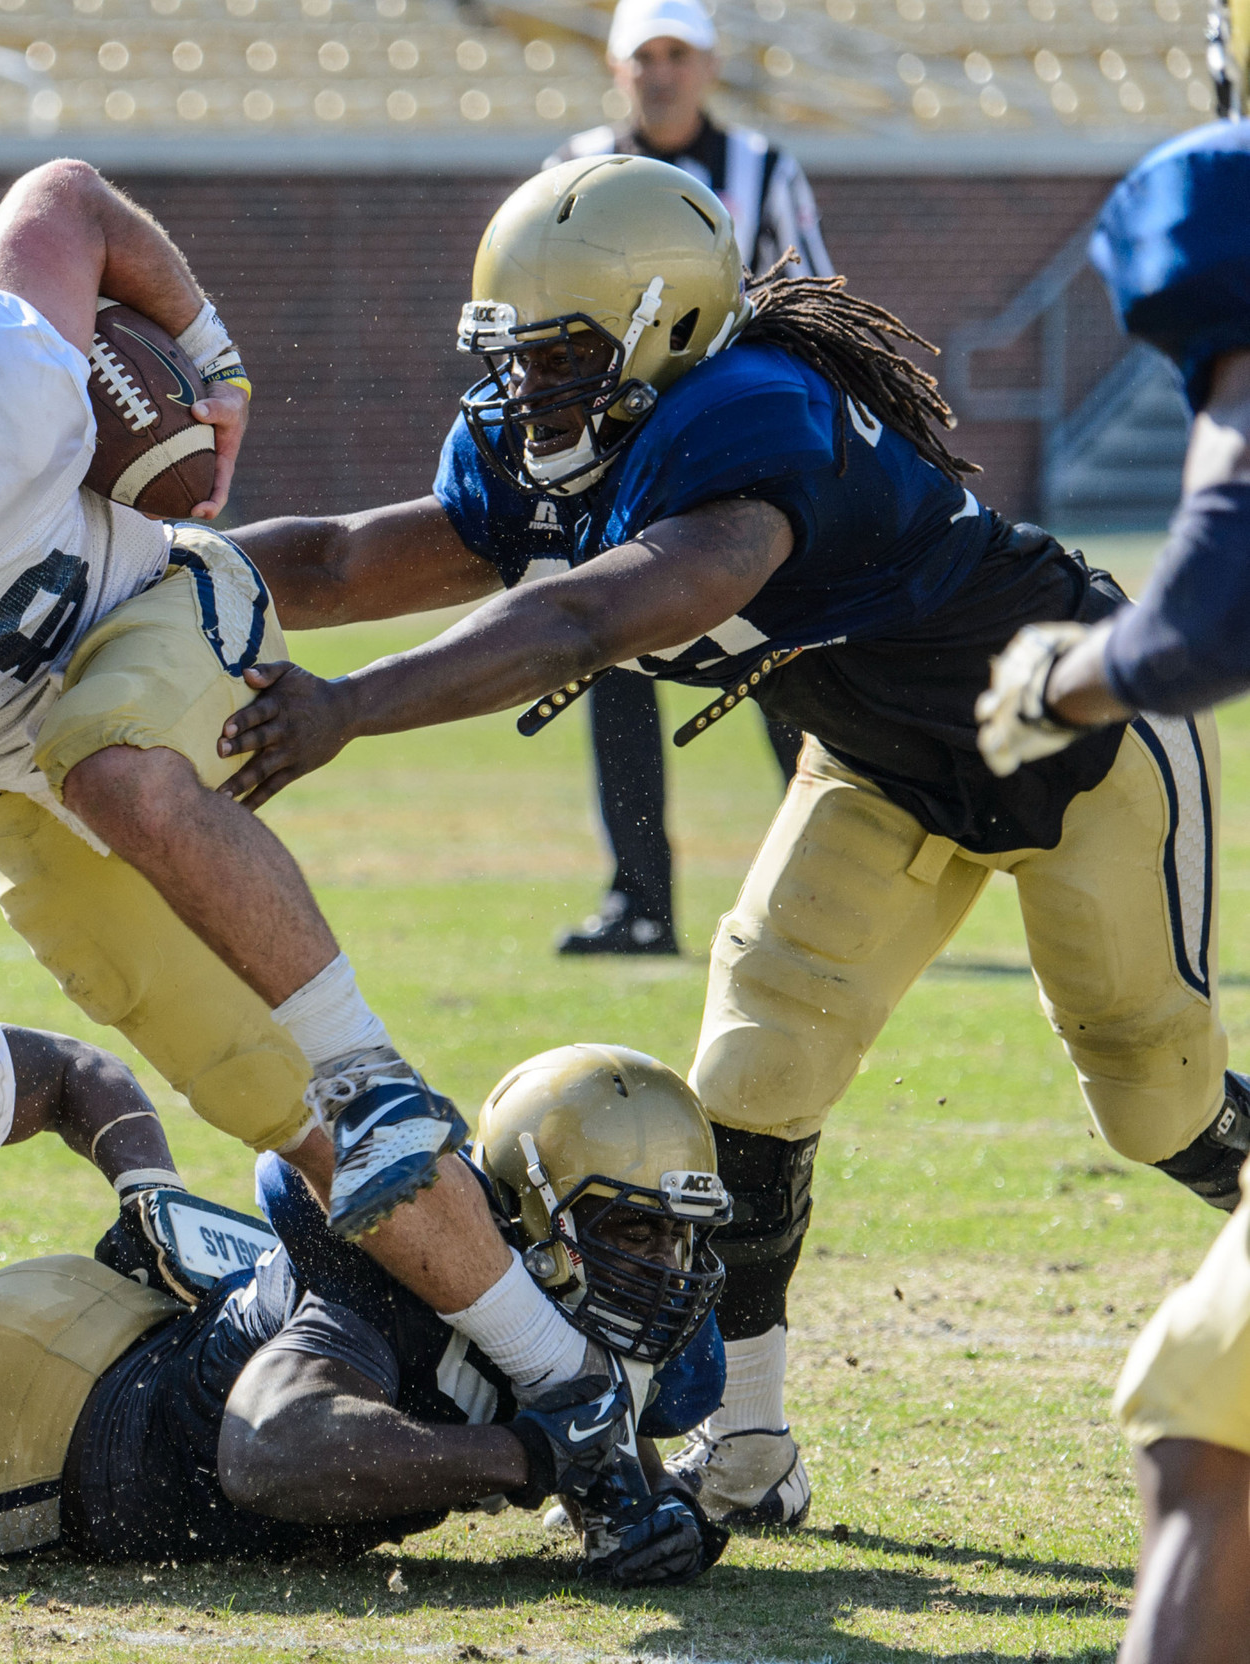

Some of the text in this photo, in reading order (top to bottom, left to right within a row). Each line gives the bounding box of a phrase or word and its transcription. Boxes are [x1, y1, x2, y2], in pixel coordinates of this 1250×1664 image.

[222, 367, 245, 378] TEAM
[681, 1174, 712, 1193] ACC
[200, 1226, 265, 1268] UGLAS
